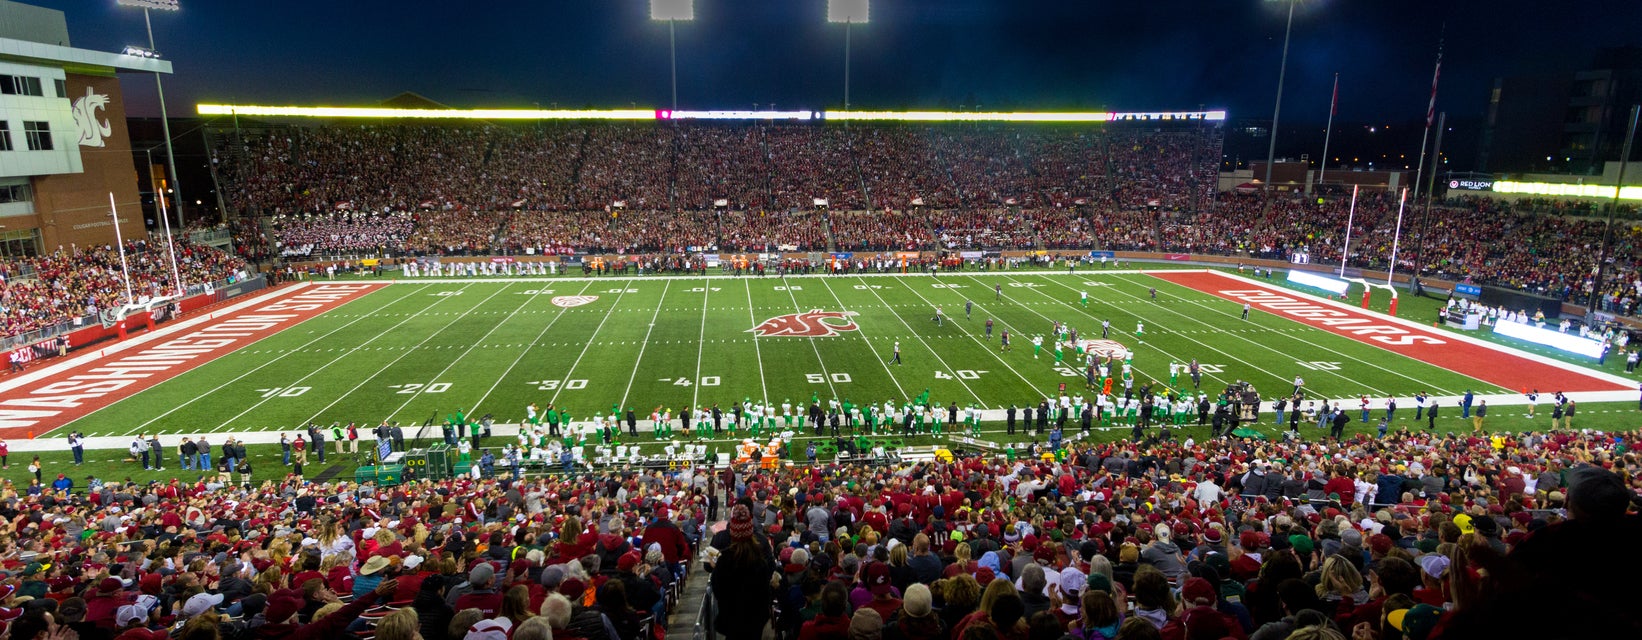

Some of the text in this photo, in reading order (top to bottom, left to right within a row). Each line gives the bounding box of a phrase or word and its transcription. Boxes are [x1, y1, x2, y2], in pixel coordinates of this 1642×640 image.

[254, 284, 372, 312] STATE
[1218, 290, 1446, 345] COUGARS
[1296, 361, 1342, 370] 10
[805, 373, 852, 384] 50
[934, 370, 980, 379] 40
[538, 379, 589, 390] 30
[673, 376, 720, 386] 40
[261, 386, 312, 398] 10
[396, 383, 453, 394] 20
